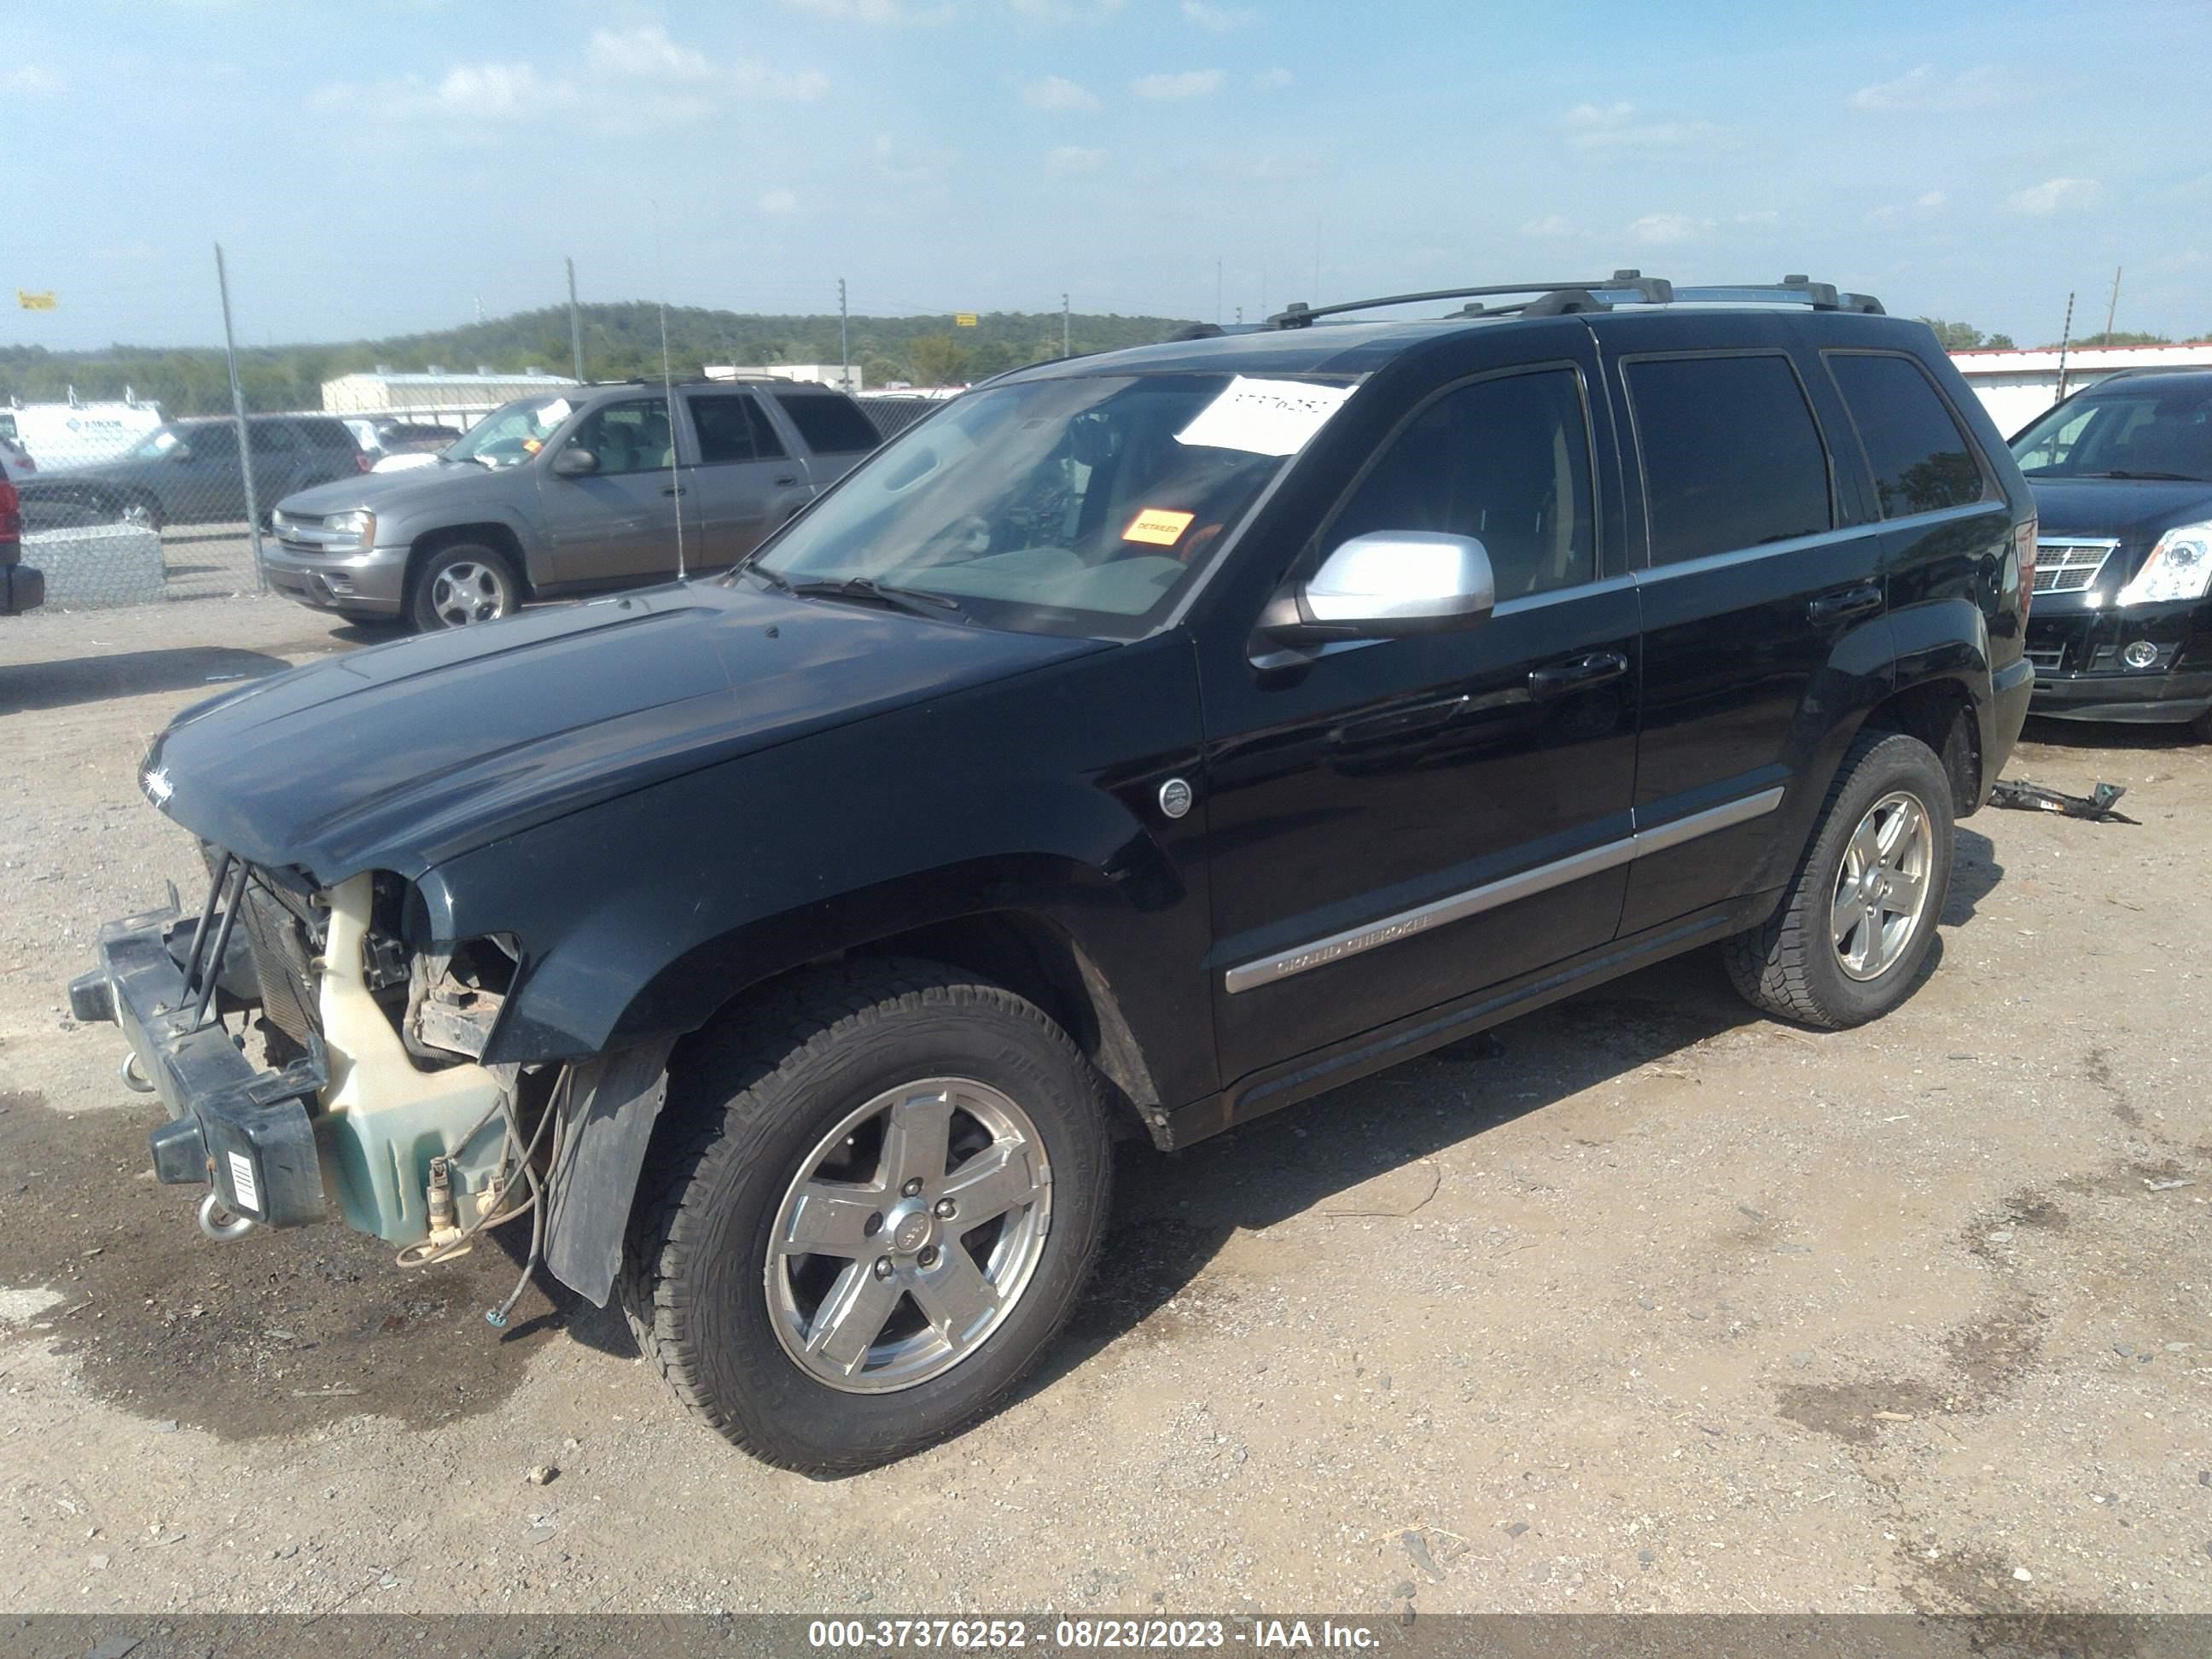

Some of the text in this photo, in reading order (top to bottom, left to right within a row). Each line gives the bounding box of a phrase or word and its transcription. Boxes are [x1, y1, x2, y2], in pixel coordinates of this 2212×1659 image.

[1138, 522, 1179, 533] DETAILED
[1278, 915, 1433, 973] GRAND CHEROKEE
